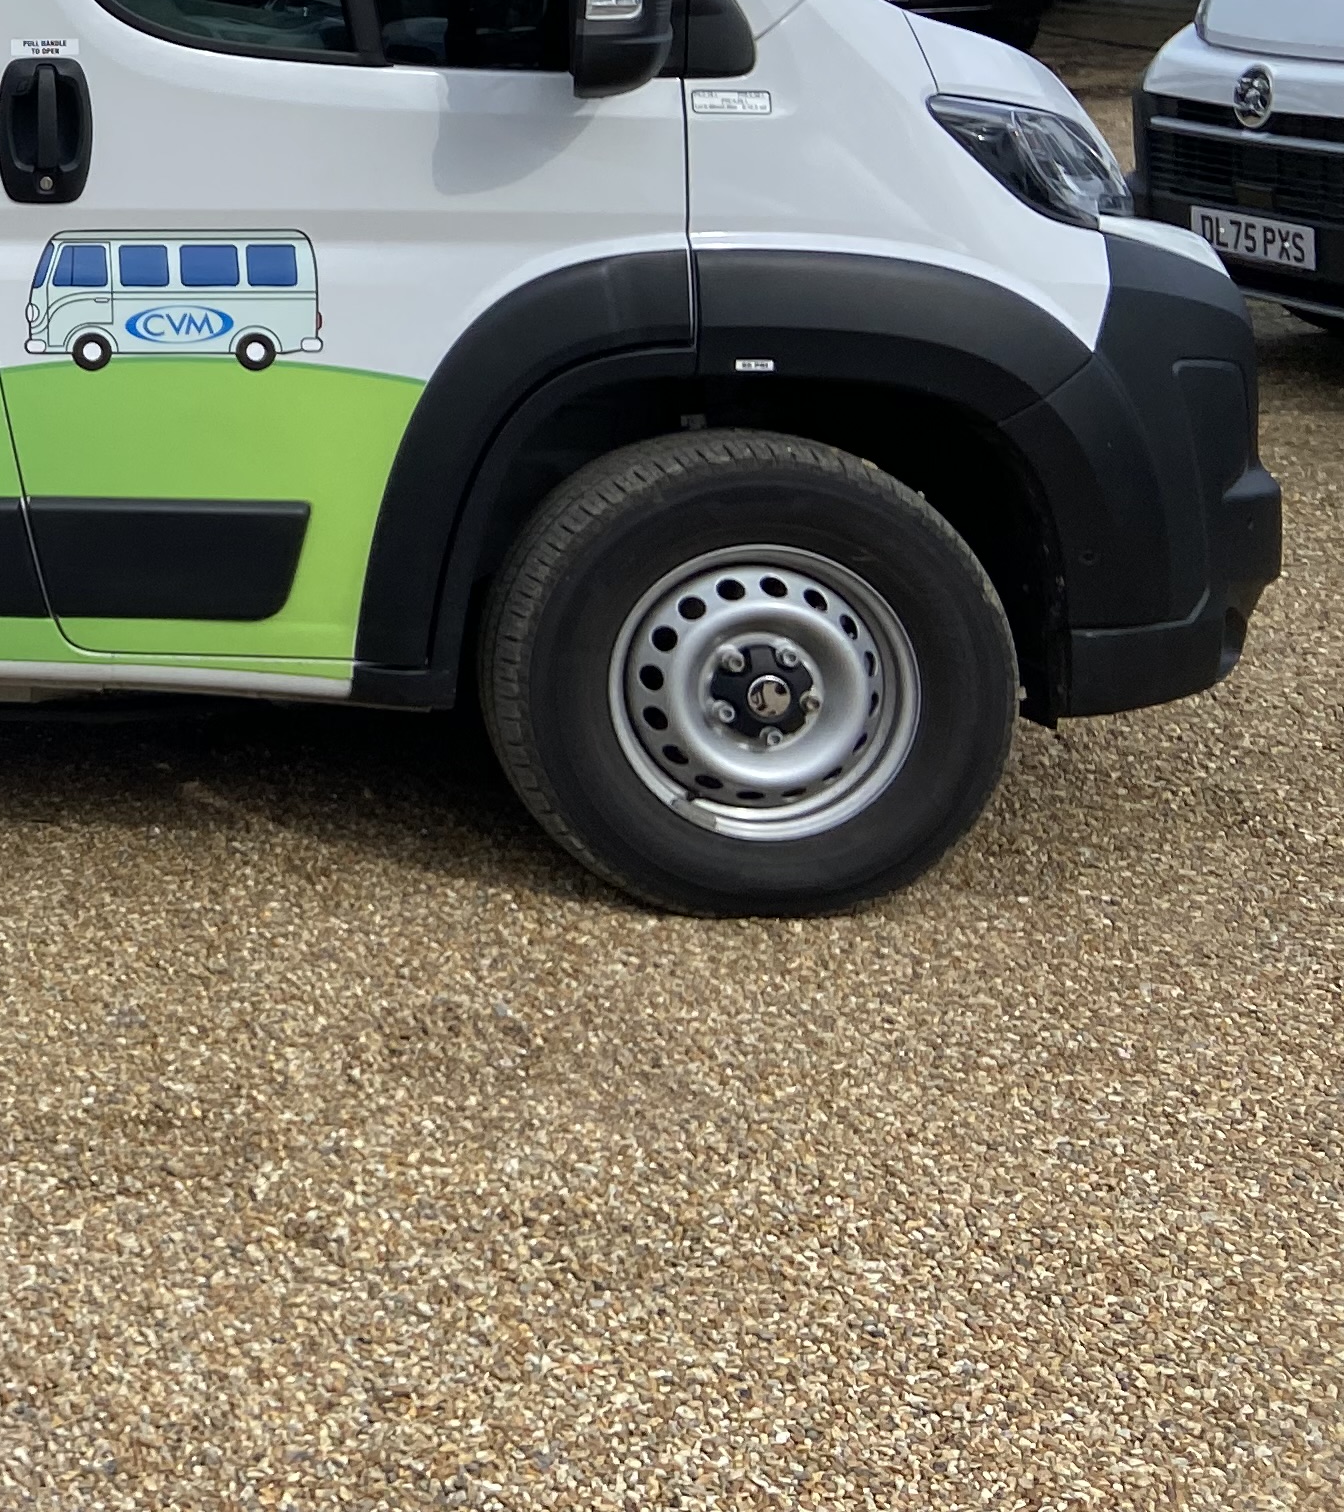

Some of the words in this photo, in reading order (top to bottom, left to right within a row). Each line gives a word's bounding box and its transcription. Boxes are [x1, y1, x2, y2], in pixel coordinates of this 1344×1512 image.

[1200, 214, 1257, 253] DL75
[1263, 226, 1306, 263] PXS
[142, 312, 214, 337] CVM
